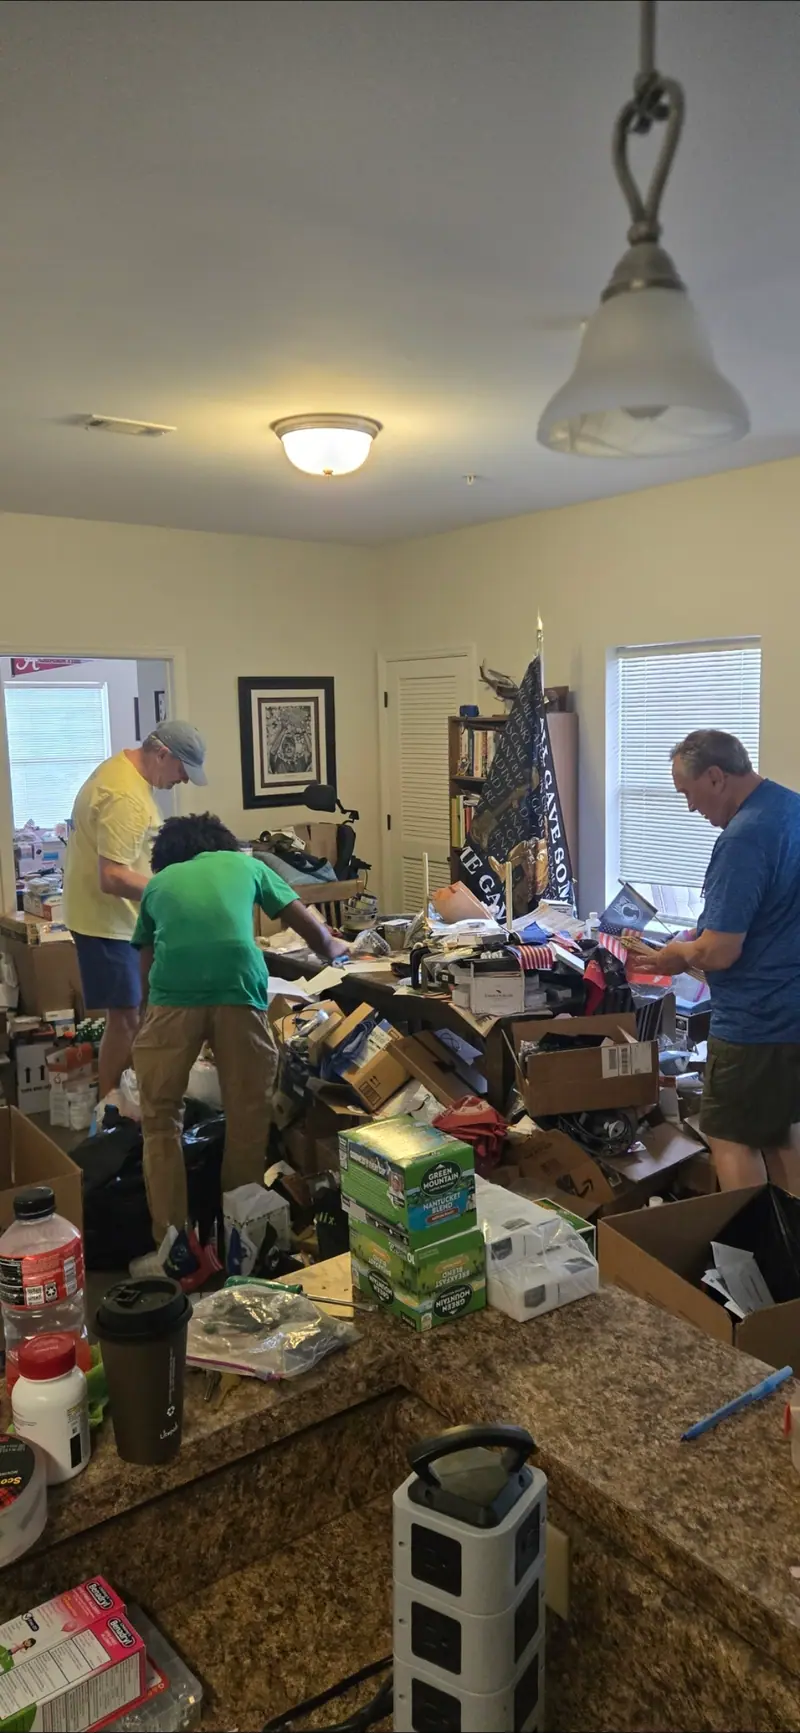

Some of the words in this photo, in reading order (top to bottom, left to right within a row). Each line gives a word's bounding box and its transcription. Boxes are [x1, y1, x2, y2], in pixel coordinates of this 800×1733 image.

[544, 770, 561, 843] GAVE
[423, 1172, 459, 1190] MOUNTAIN
[428, 1167, 453, 1181] GREEN
[423, 1192, 461, 1211] NANTUCKET
[432, 1202, 453, 1214] BLEND
[435, 1270, 471, 1288] BREAKFAST
[442, 1267, 463, 1279] BLEND
[435, 1288, 471, 1308] MOUNTAIN
[441, 1298, 466, 1312] GREEN
[88, 1583, 111, 1608] Benadryl
[109, 1619, 133, 1647] Benadryl
